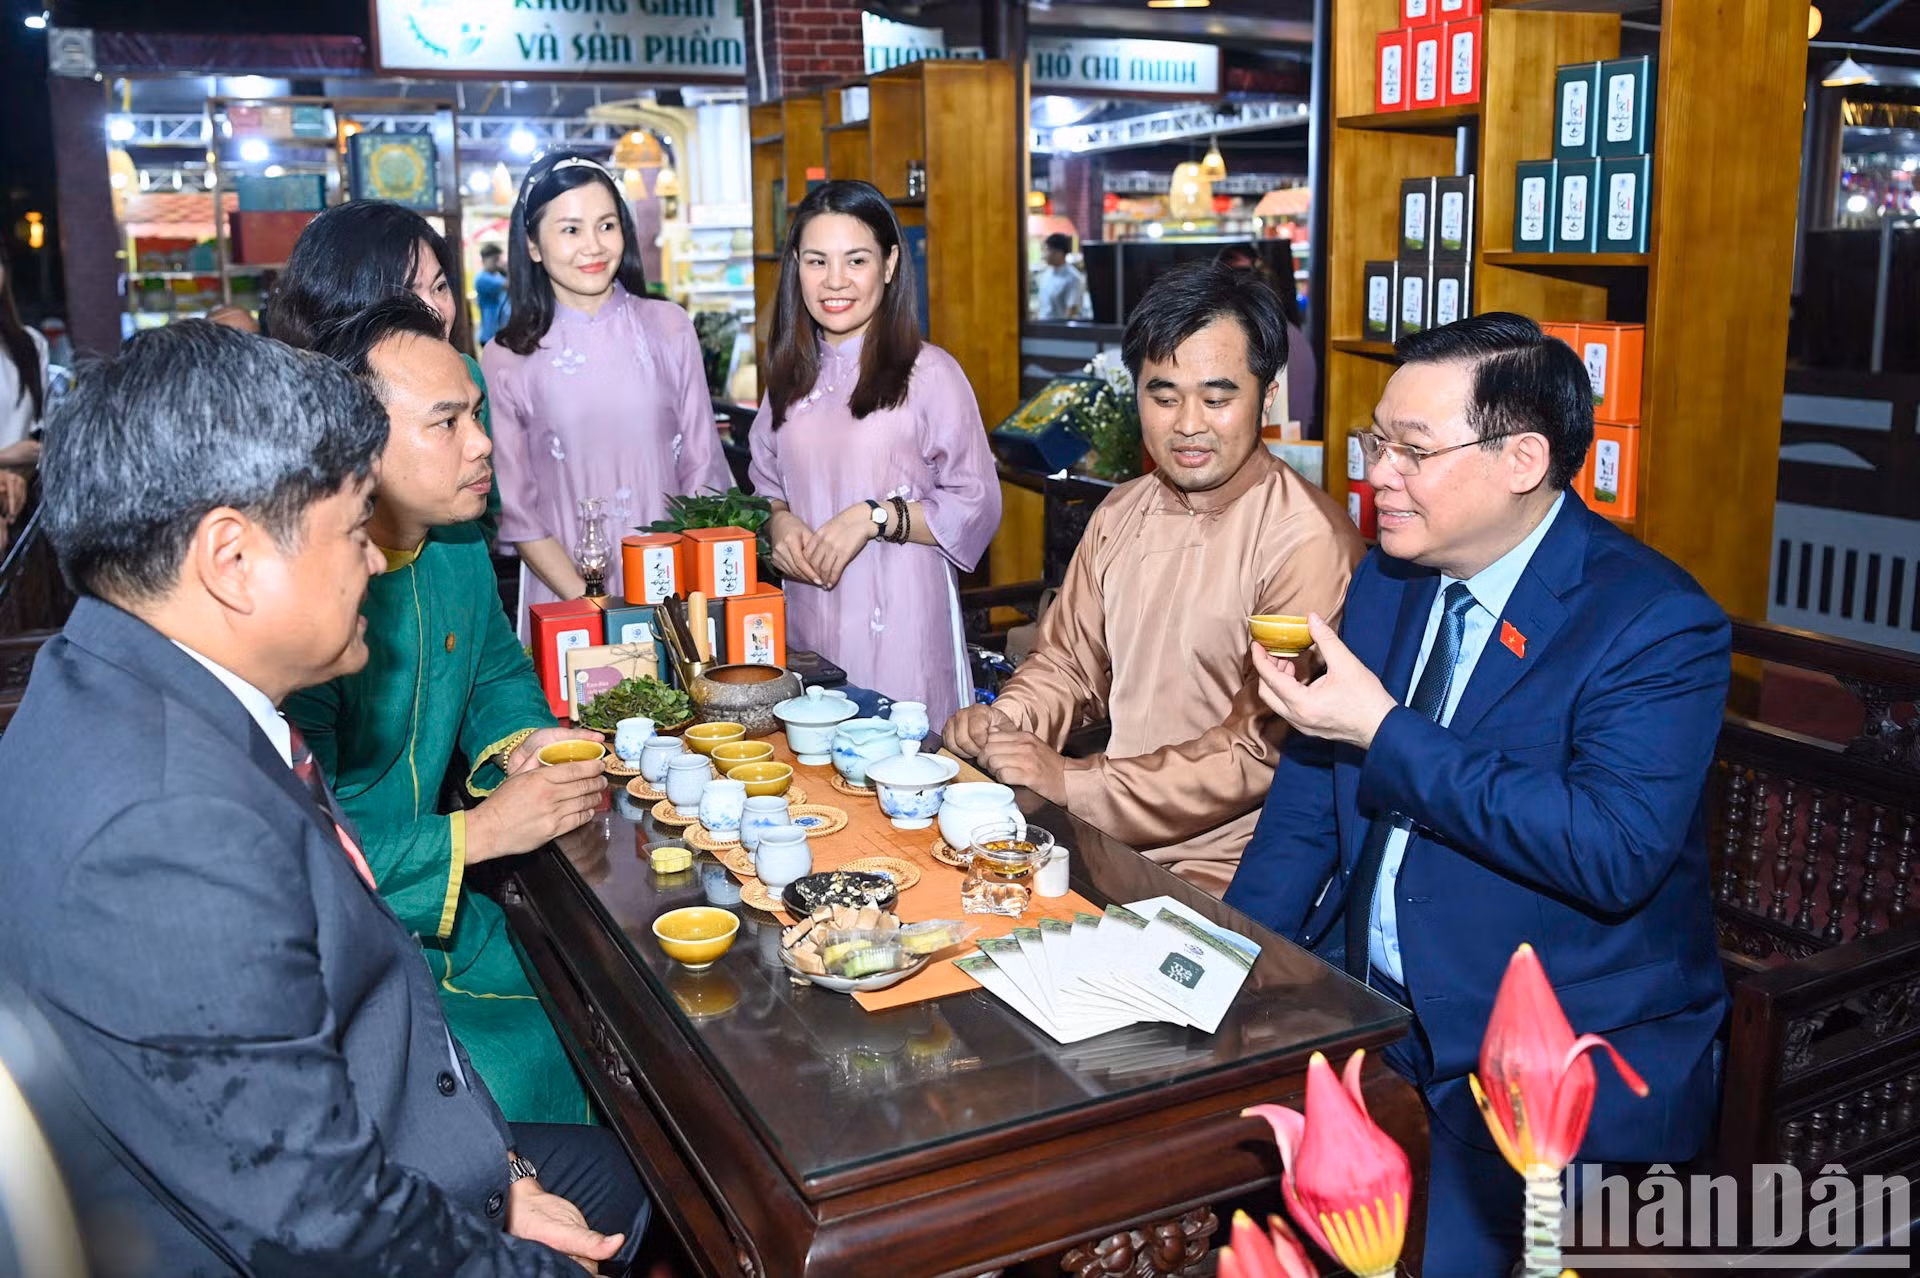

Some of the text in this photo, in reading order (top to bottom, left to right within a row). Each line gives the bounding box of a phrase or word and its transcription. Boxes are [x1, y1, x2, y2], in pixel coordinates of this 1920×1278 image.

[515, 19, 742, 65] VÀ SẢN PHẨM
[1036, 43, 1071, 79] HỒ
[1082, 46, 1119, 80] CHÍ
[1129, 59, 1196, 83] MINH
